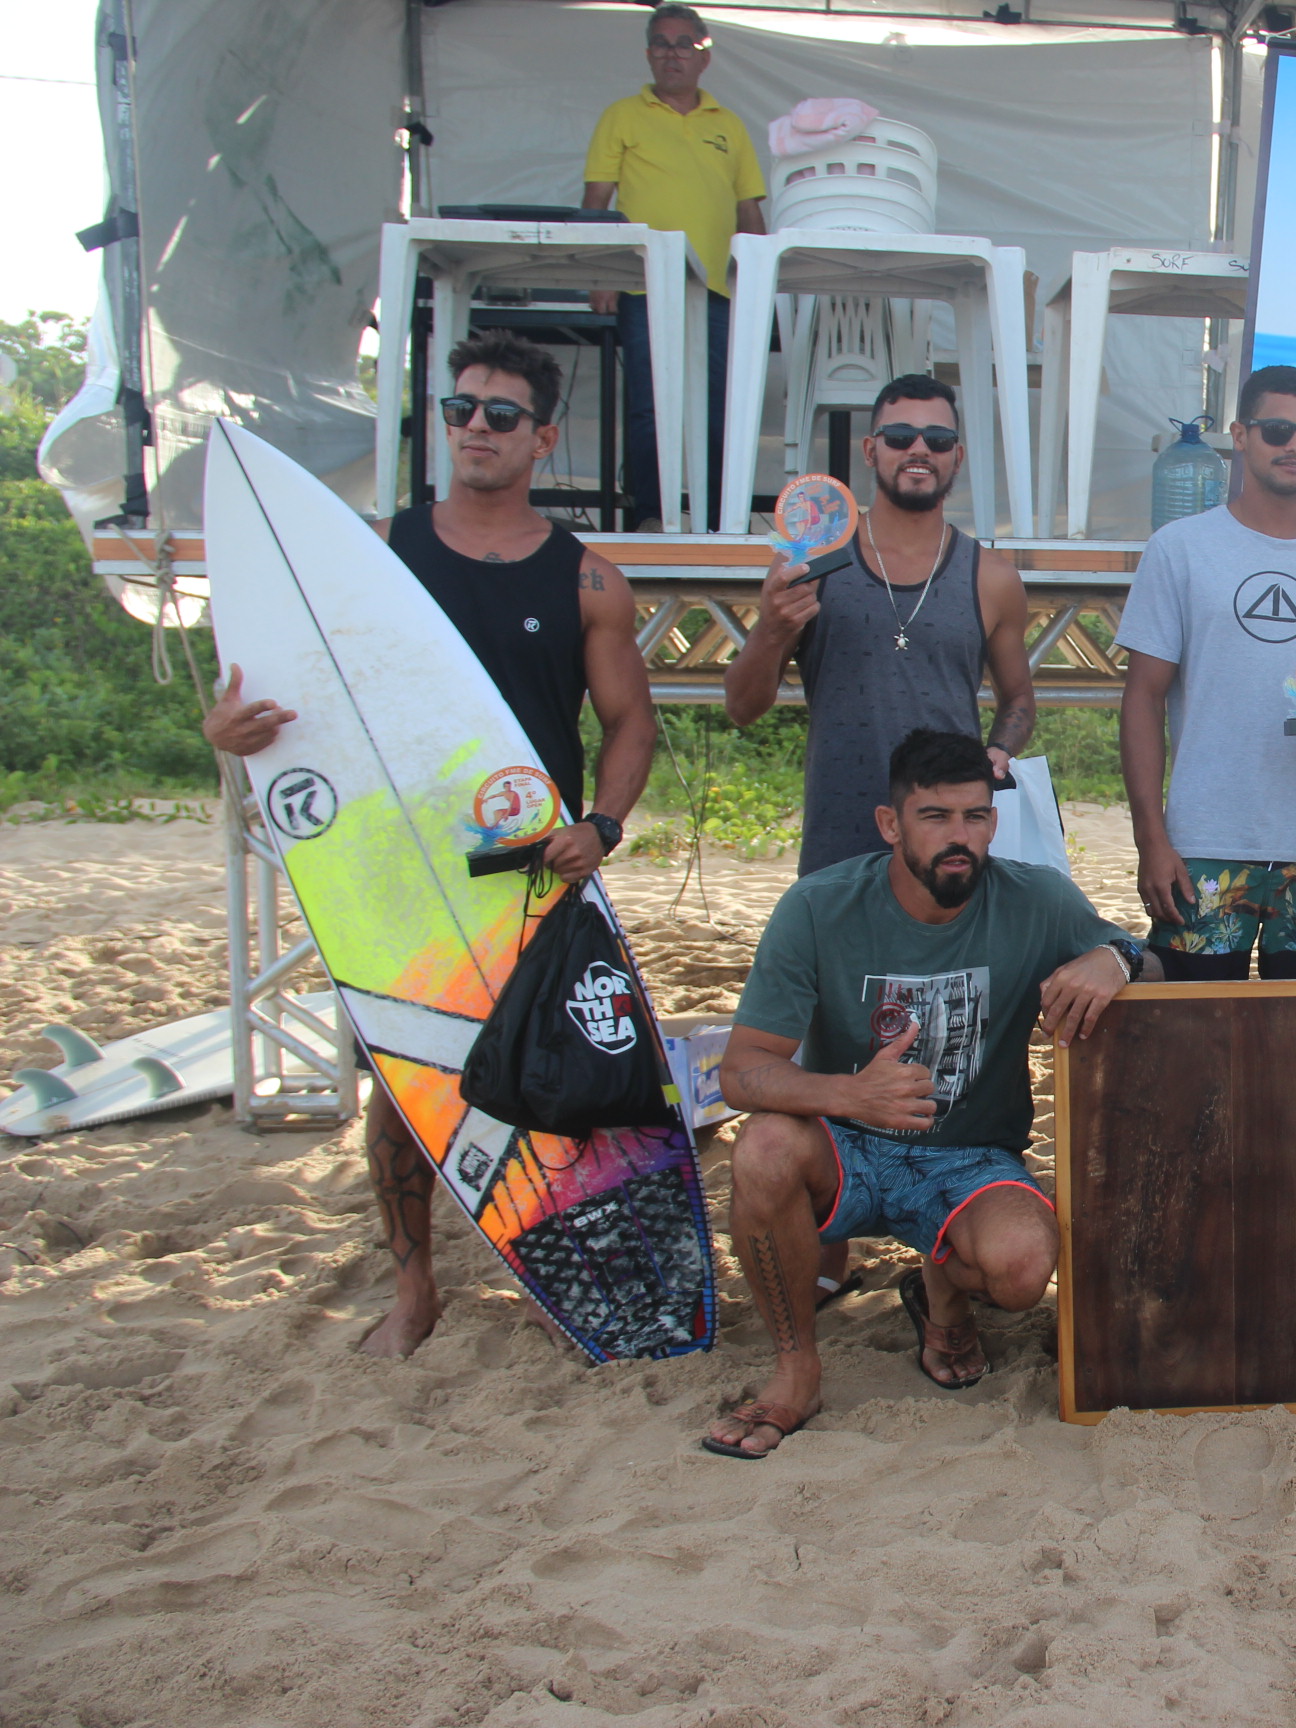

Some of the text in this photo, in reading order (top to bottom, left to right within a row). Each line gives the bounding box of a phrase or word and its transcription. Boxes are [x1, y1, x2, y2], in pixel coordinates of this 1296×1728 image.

[1150, 253, 1194, 271] SURF
[777, 484, 796, 515] CIRCUITO
[586, 1015, 637, 1043] SEA
